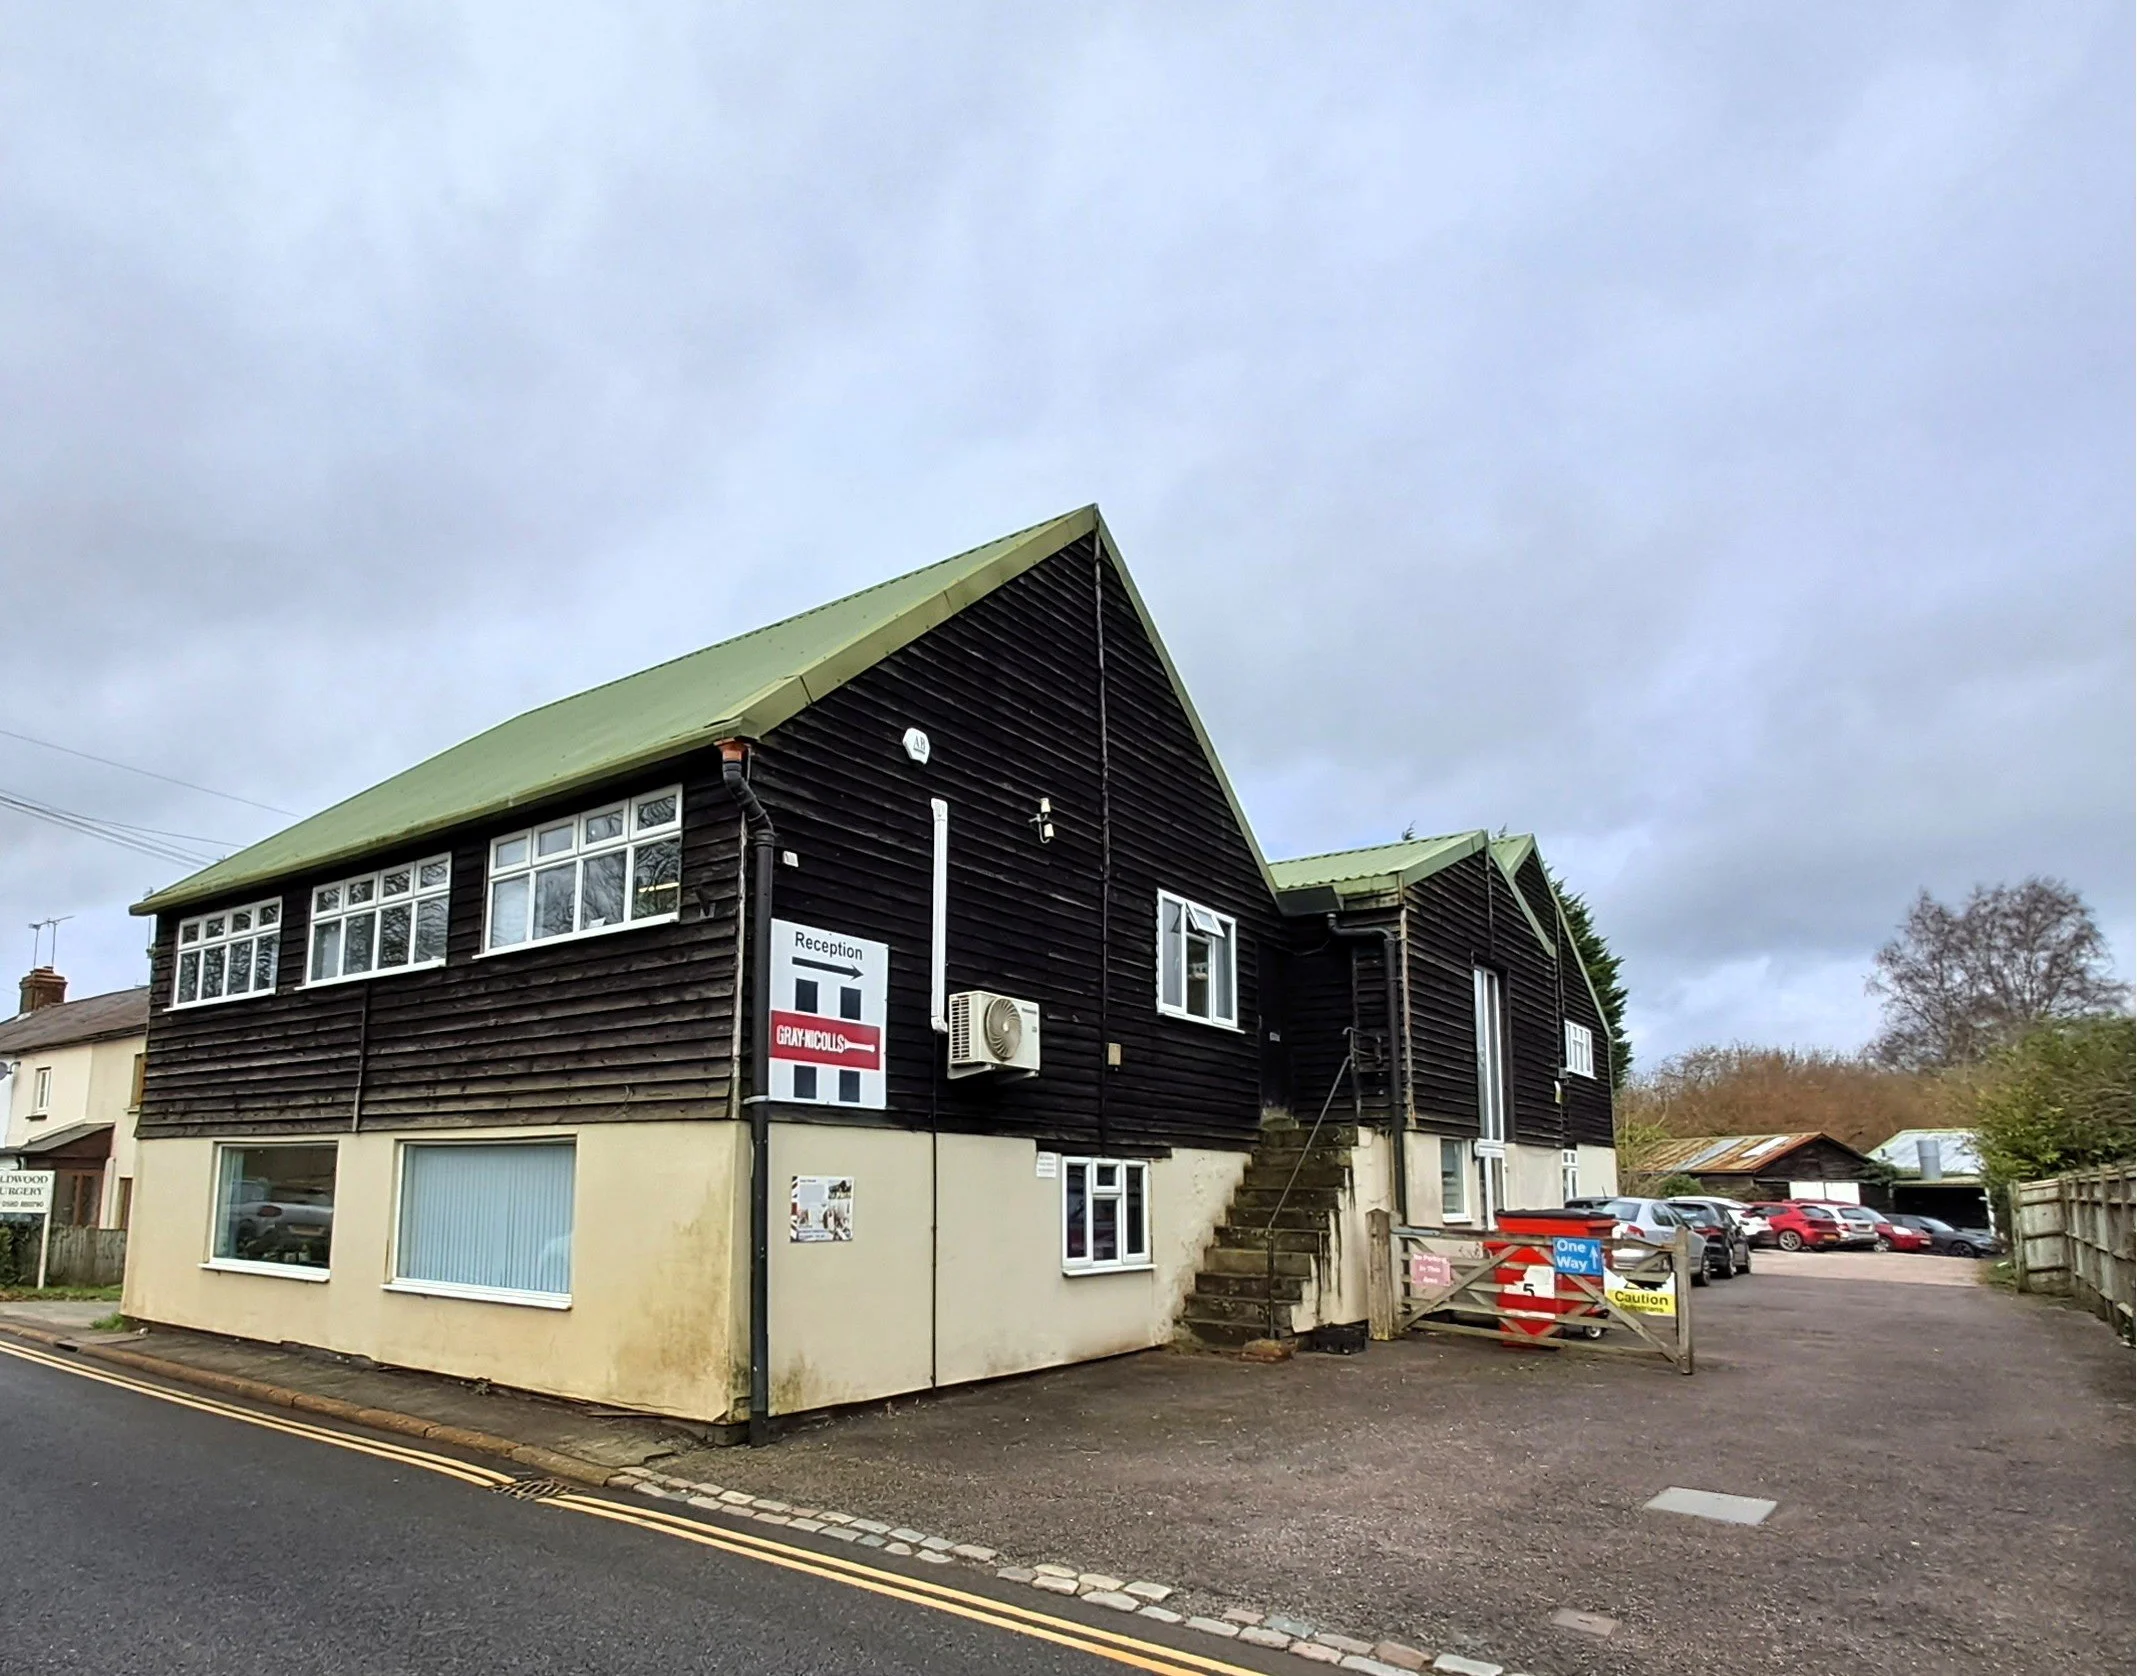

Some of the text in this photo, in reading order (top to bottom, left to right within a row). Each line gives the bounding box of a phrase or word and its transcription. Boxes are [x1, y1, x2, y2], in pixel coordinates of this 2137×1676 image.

[795, 931, 863, 960] Reception
[776, 1024, 845, 1054] GRAY-NICOLLS
[1556, 1239, 1586, 1253] One
[1556, 1256, 1588, 1273] Way
[1614, 1290, 1669, 1306] Caution
